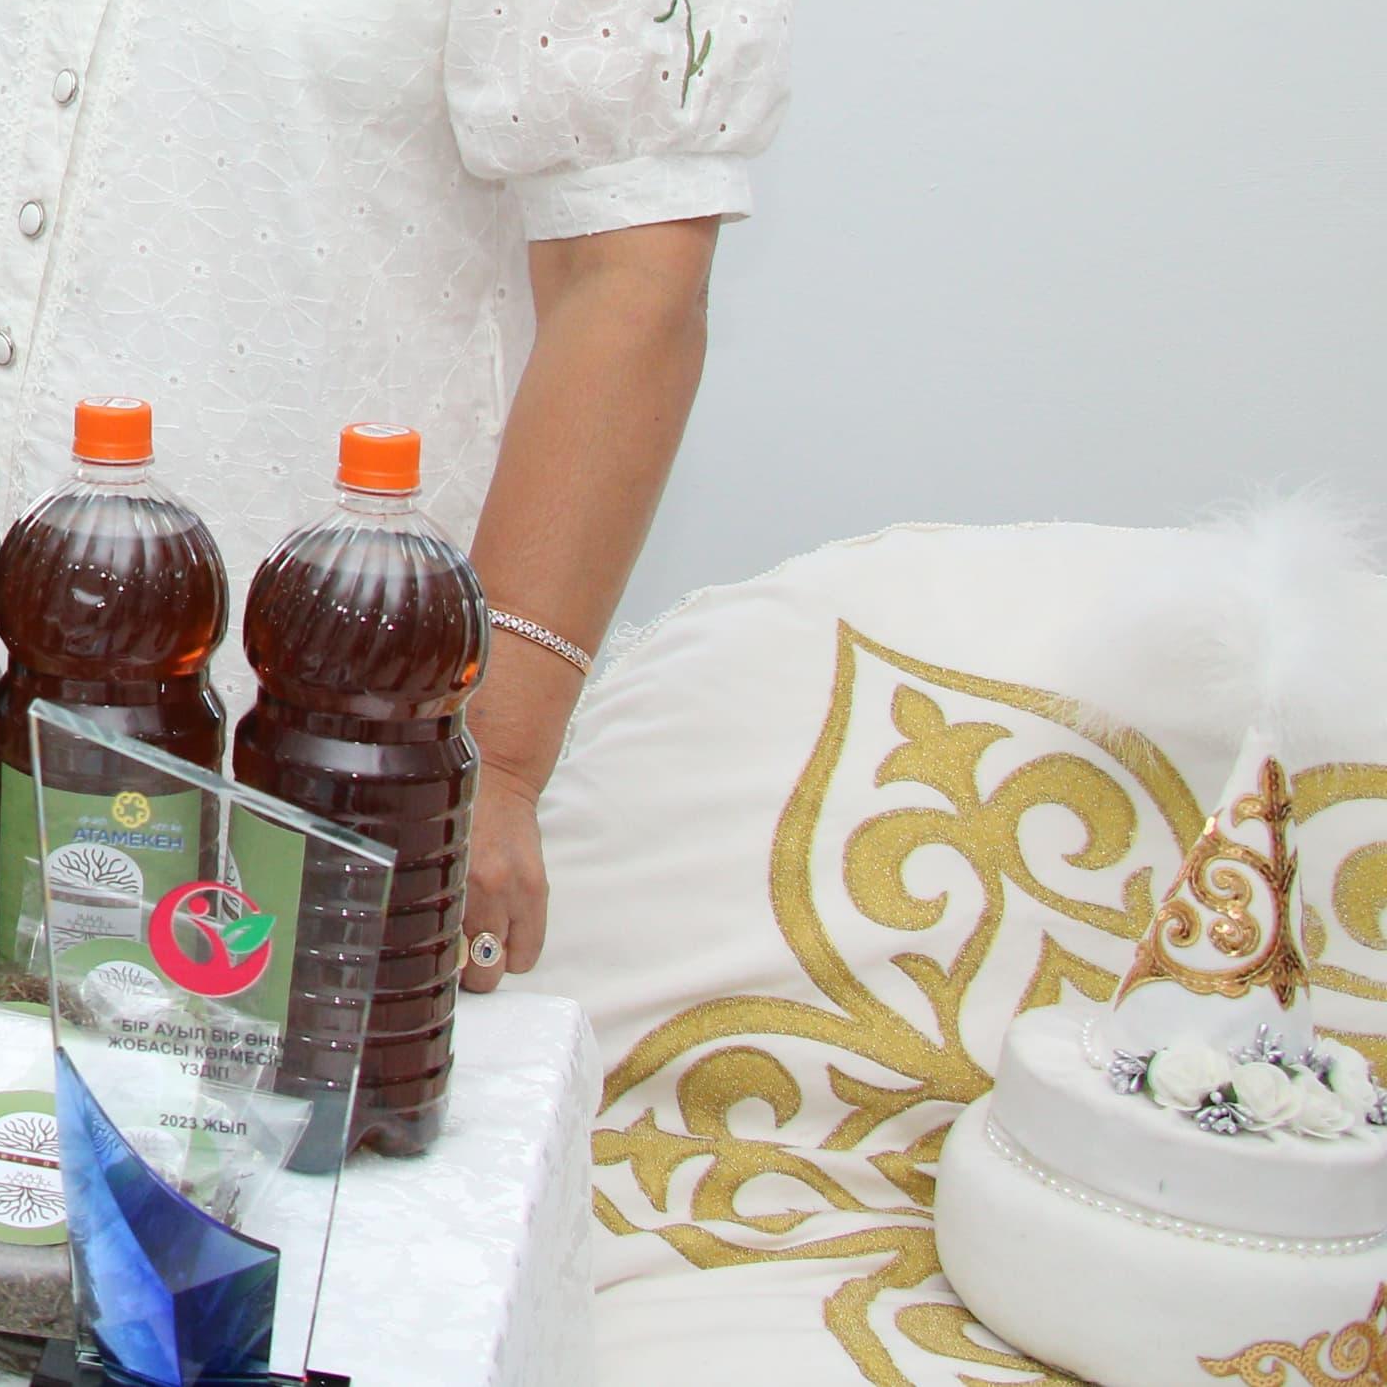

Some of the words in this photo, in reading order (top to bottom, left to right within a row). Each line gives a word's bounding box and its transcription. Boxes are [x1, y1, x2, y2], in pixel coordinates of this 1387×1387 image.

[154, 1022, 206, 1041] АУЫЛ
[211, 1028, 241, 1045] БІР
[106, 1035, 190, 1058] ЖОБАСЫ
[159, 1113, 198, 1131] 2023
